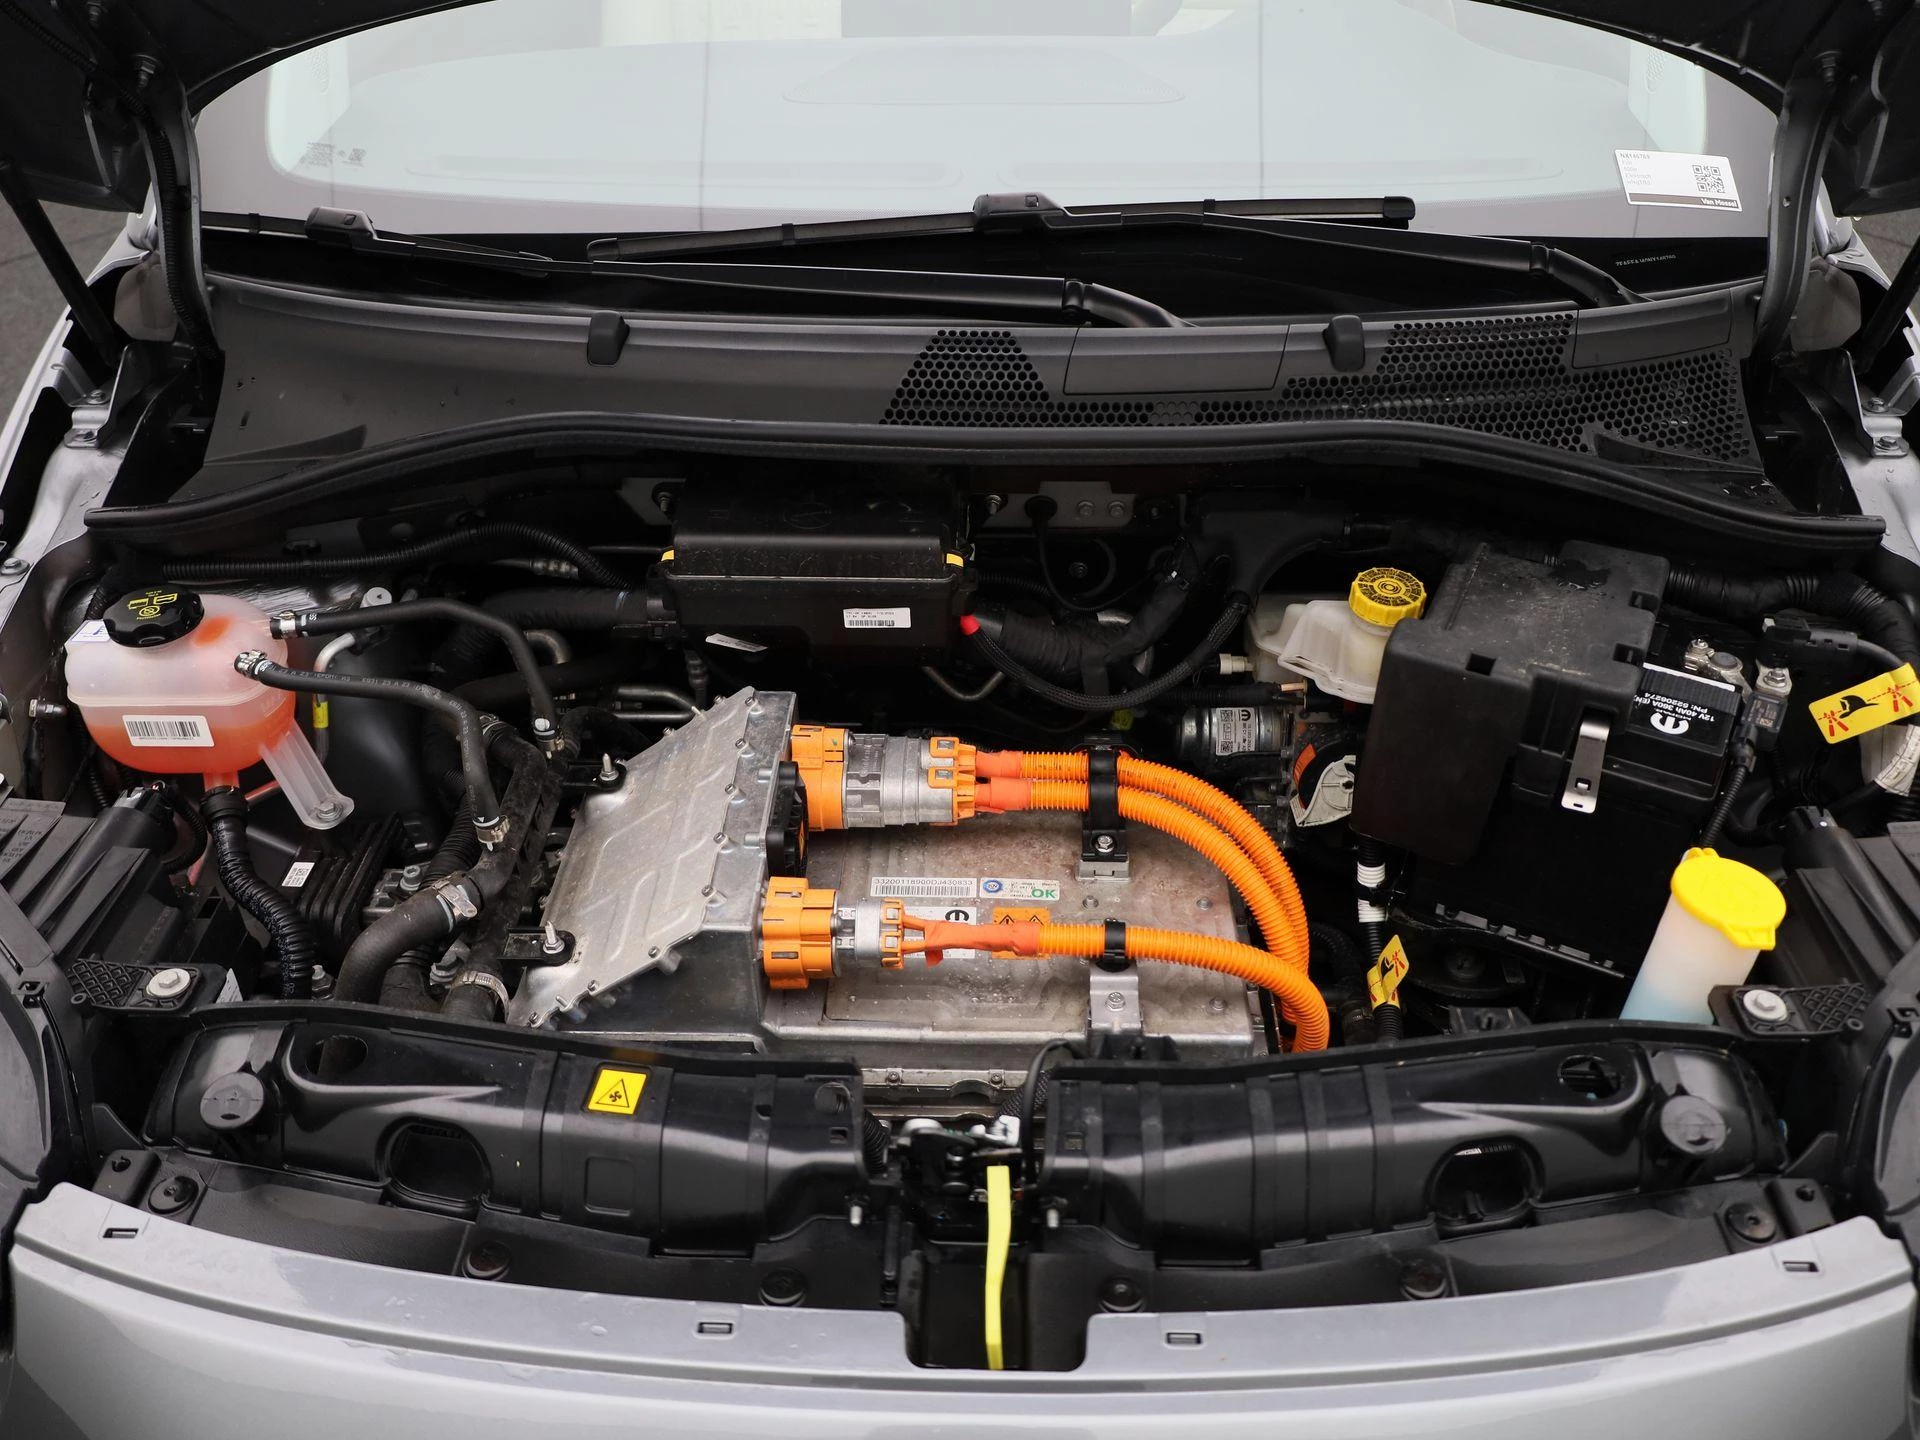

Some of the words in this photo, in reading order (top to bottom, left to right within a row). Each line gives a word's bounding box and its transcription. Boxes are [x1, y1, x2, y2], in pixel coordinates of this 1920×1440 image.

[1652, 700, 1674, 711] 360A
[1690, 704, 1708, 714] PN:
[1675, 706, 1698, 717] 40Ah
[1698, 713, 1715, 722] 12V
[1031, 888, 1056, 899] OK
